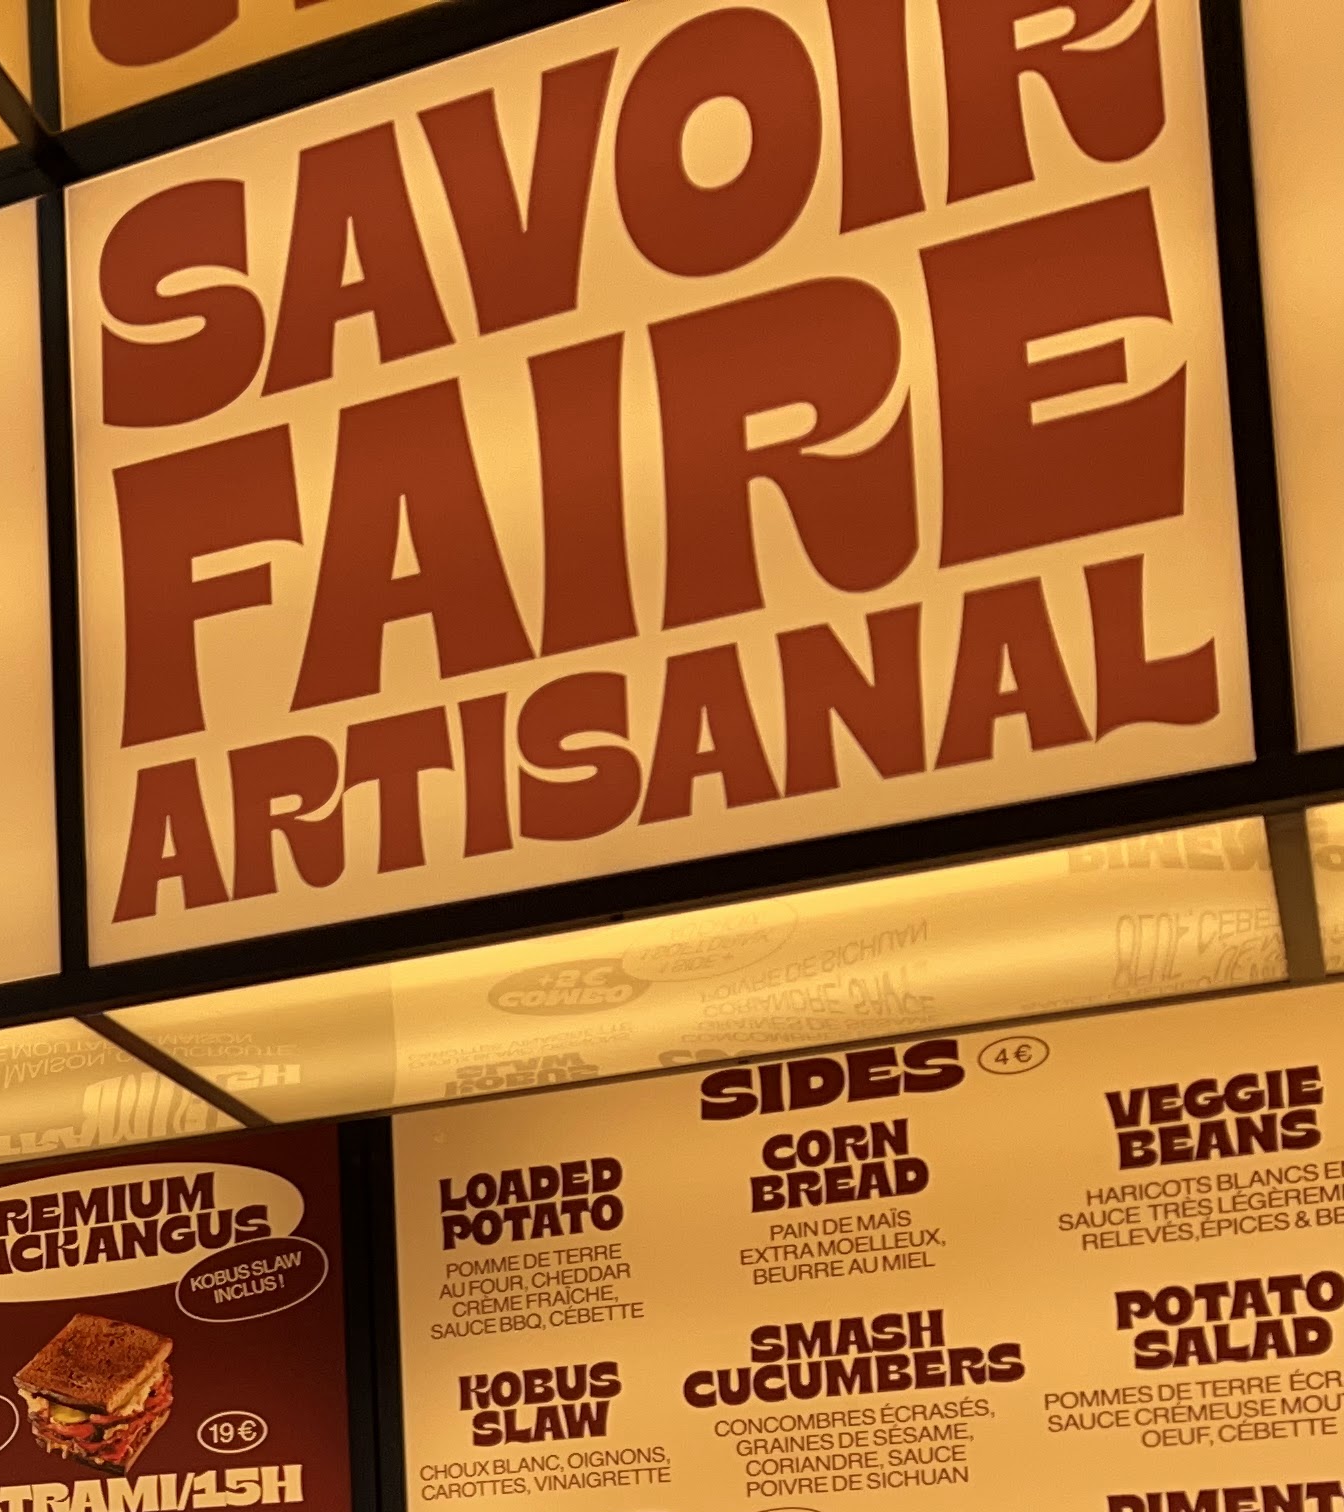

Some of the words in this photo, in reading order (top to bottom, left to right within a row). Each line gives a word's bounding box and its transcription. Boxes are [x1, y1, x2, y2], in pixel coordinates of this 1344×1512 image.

[98, 0, 1167, 428] SAVOIR
[112, 187, 1188, 749] FAIRE
[112, 553, 1221, 924] ARTISANAL
[700, 1038, 965, 1121] SIDES
[1104, 1065, 1323, 1130] VEGGIE
[762, 1118, 909, 1172] CORN
[1117, 1108, 1321, 1171] BEANS
[438, 1157, 623, 1214] LOADED
[749, 1157, 929, 1213] BREAD
[441, 1194, 624, 1251] POTATO
[769, 1220, 819, 1242] PAIN
[822, 1216, 854, 1236] DE
[856, 1207, 912, 1232] MAÏS
[445, 1254, 521, 1280] POMME
[523, 1251, 551, 1270] DE
[552, 1242, 622, 1266] TERRE
[451, 1294, 523, 1318] CRÈME
[525, 1284, 619, 1310] FRAÎCHE,
[1114, 1270, 1344, 1331] POTATO
[750, 1309, 946, 1364] SMASH
[1134, 1316, 1333, 1370] SALAD
[458, 1361, 622, 1411] KOBUS
[683, 1342, 1025, 1409] CUCUMBERS
[472, 1400, 610, 1447] SLAW
[714, 1408, 877, 1438] CONCOMBRES
[880, 1396, 995, 1428] ÉCRASÉS,
[735, 1432, 835, 1457] GRAINES
[838, 1430, 870, 1449] DE
[872, 1422, 975, 1447] SÉSAME,
[1141, 1426, 1214, 1448] OEUF,
[1217, 1416, 1339, 1443] CÉBETTE
[421, 1477, 531, 1501] CAROTTES,
[533, 1466, 672, 1492] VINAIGRETTE
